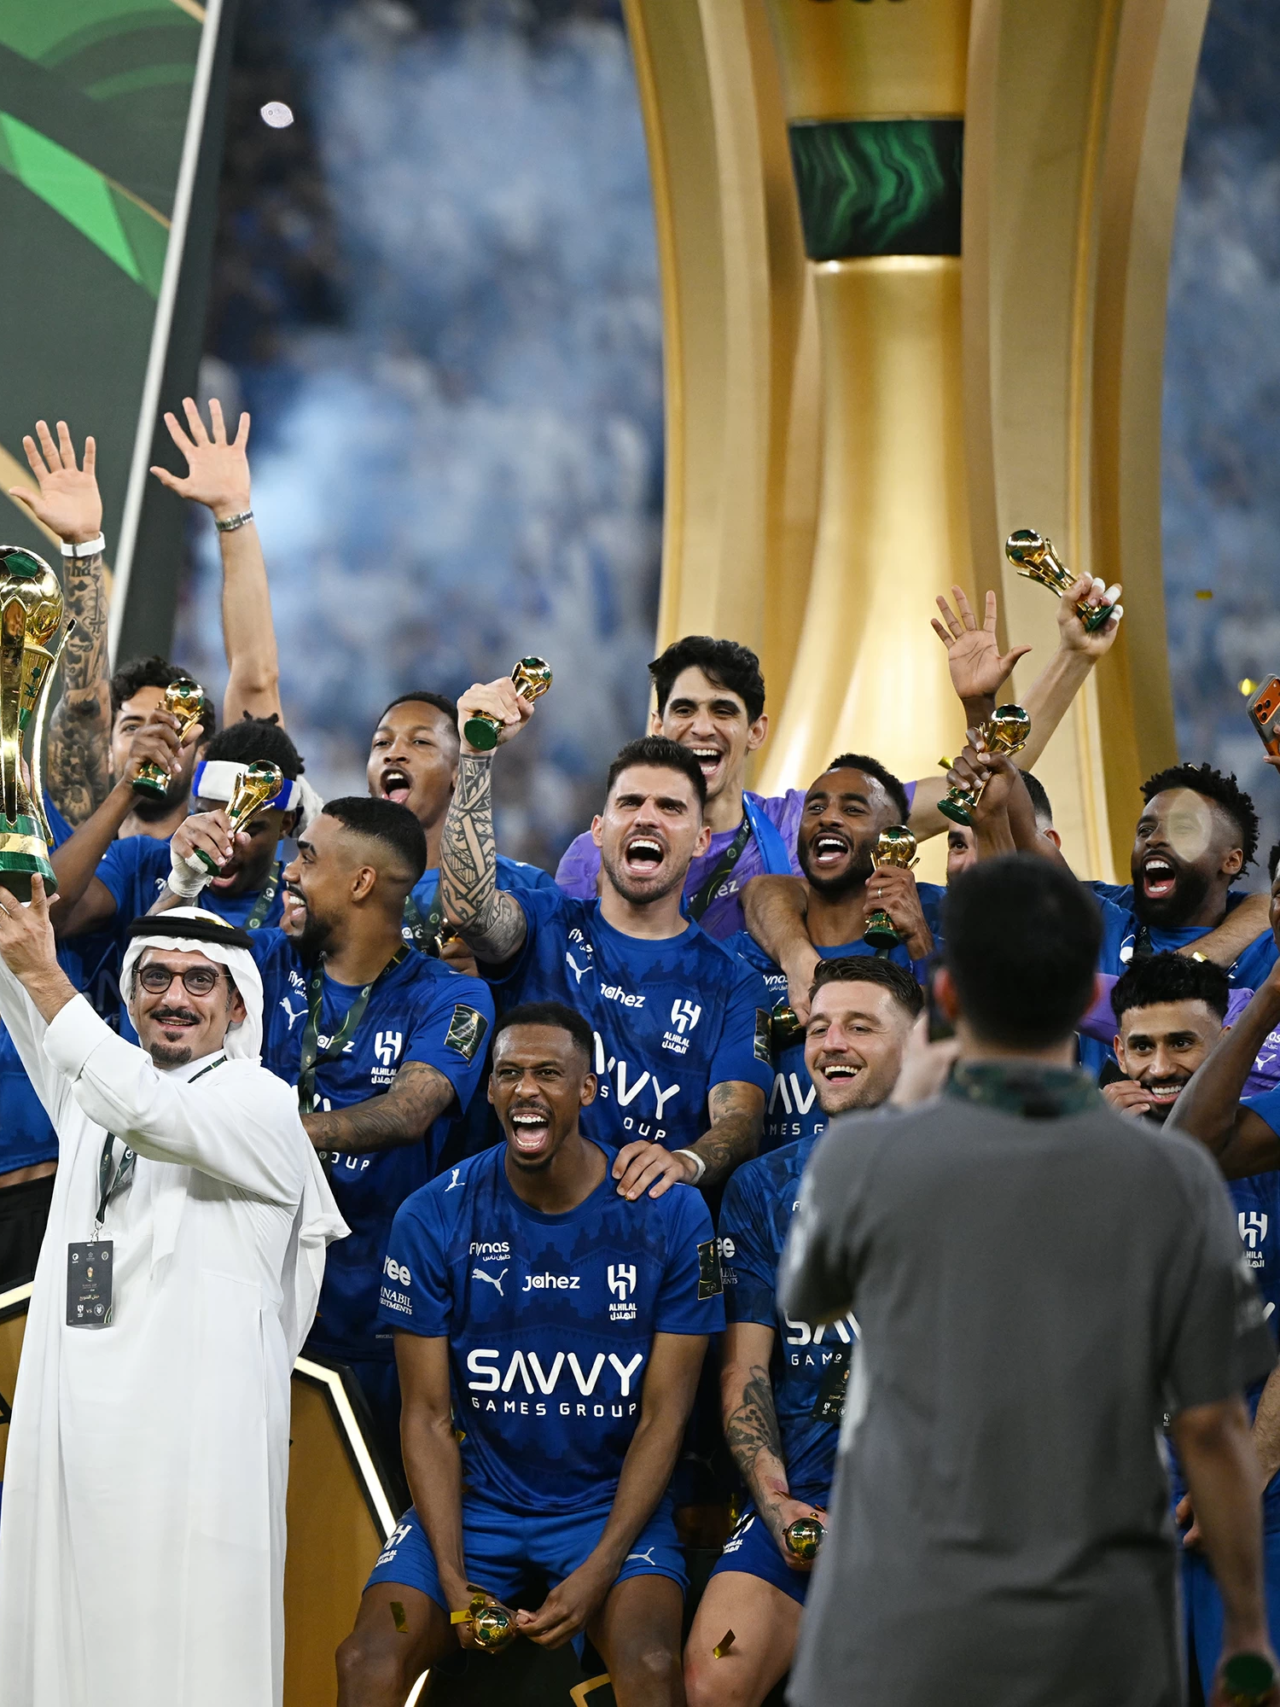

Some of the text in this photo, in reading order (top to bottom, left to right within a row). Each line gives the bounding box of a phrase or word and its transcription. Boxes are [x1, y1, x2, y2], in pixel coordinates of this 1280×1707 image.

[624, 1117, 666, 1141] OUP
[609, 1302, 637, 1311] ALHILAL
[791, 1352, 833, 1367] GAM
[467, 1349, 643, 1397] SAVVY
[472, 1397, 637, 1417] GAMES GROUP
